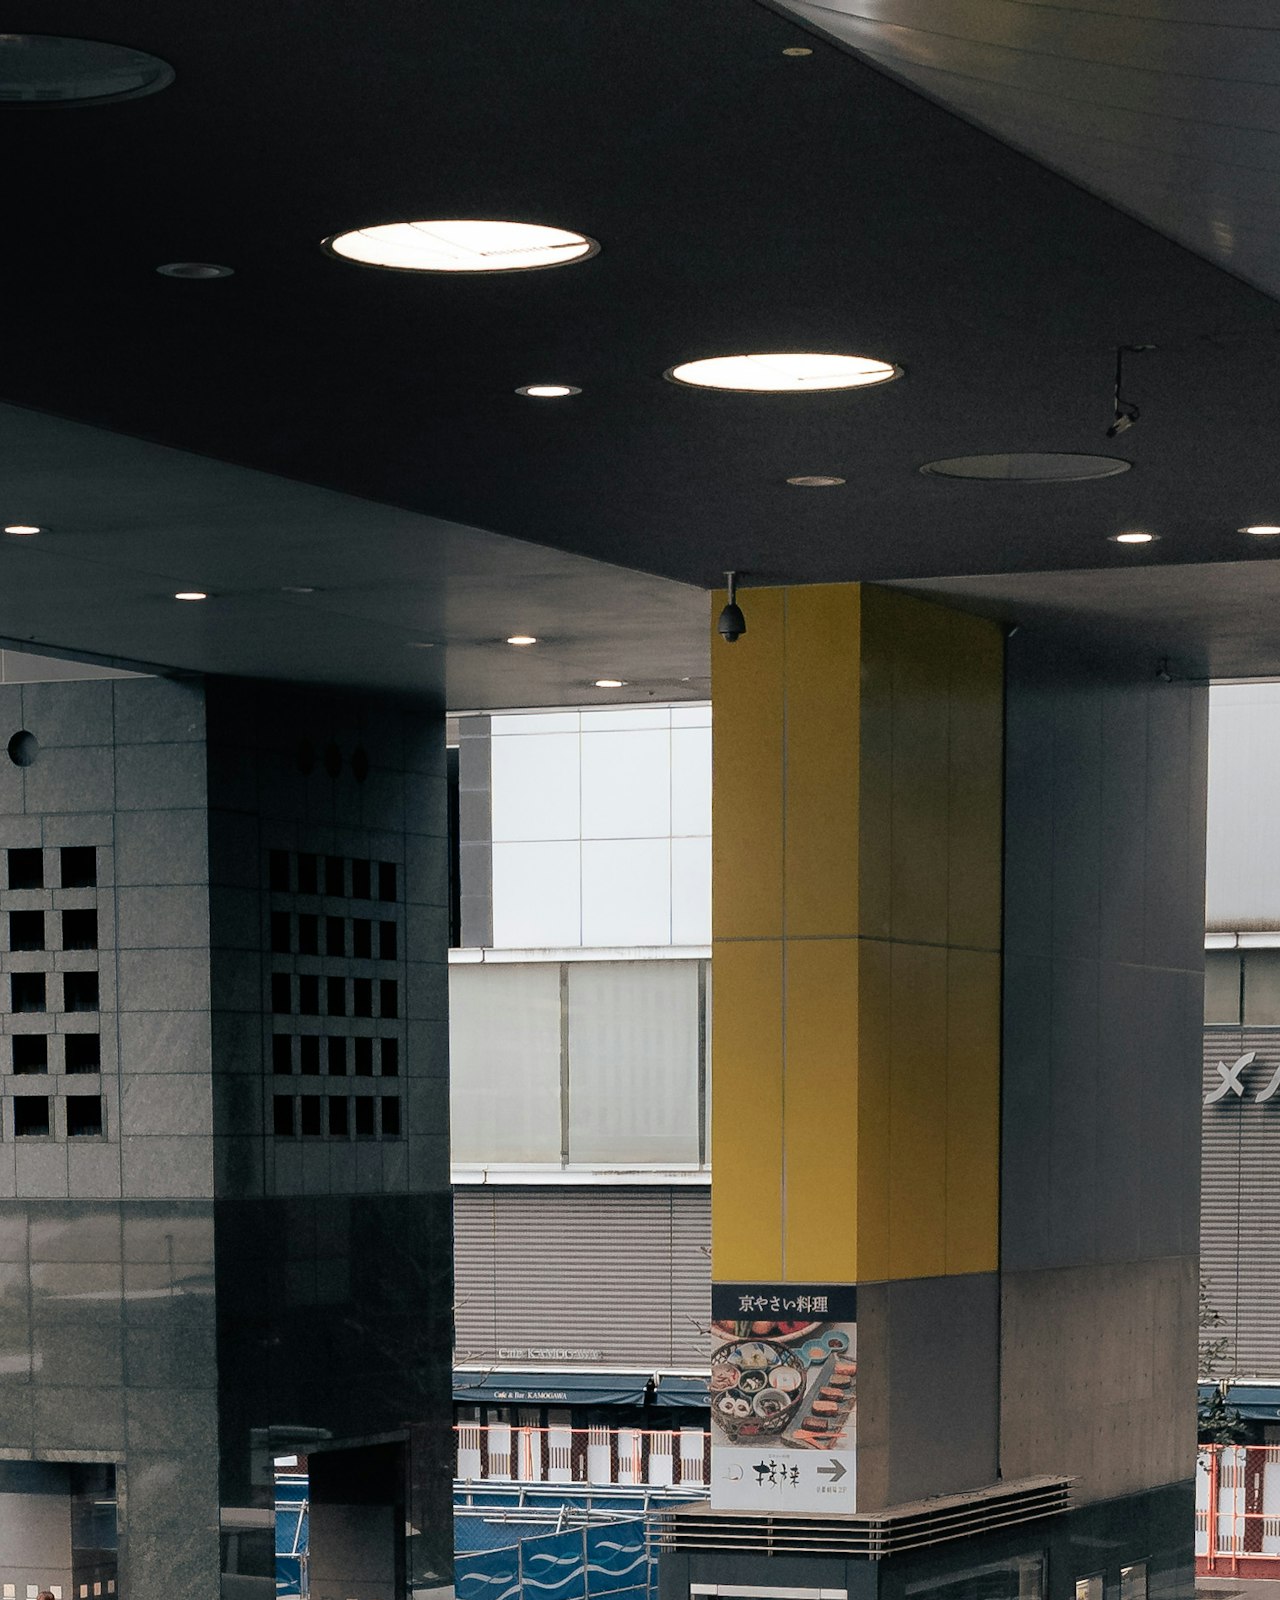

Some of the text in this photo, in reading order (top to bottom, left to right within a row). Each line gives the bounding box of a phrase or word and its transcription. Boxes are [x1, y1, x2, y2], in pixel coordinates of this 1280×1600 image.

[738, 1294, 829, 1313] 京やさい料理
[493, 1390, 507, 1399] Cafe
[514, 1391, 525, 1400] Bar
[527, 1391, 568, 1400] KAMOGAWA
